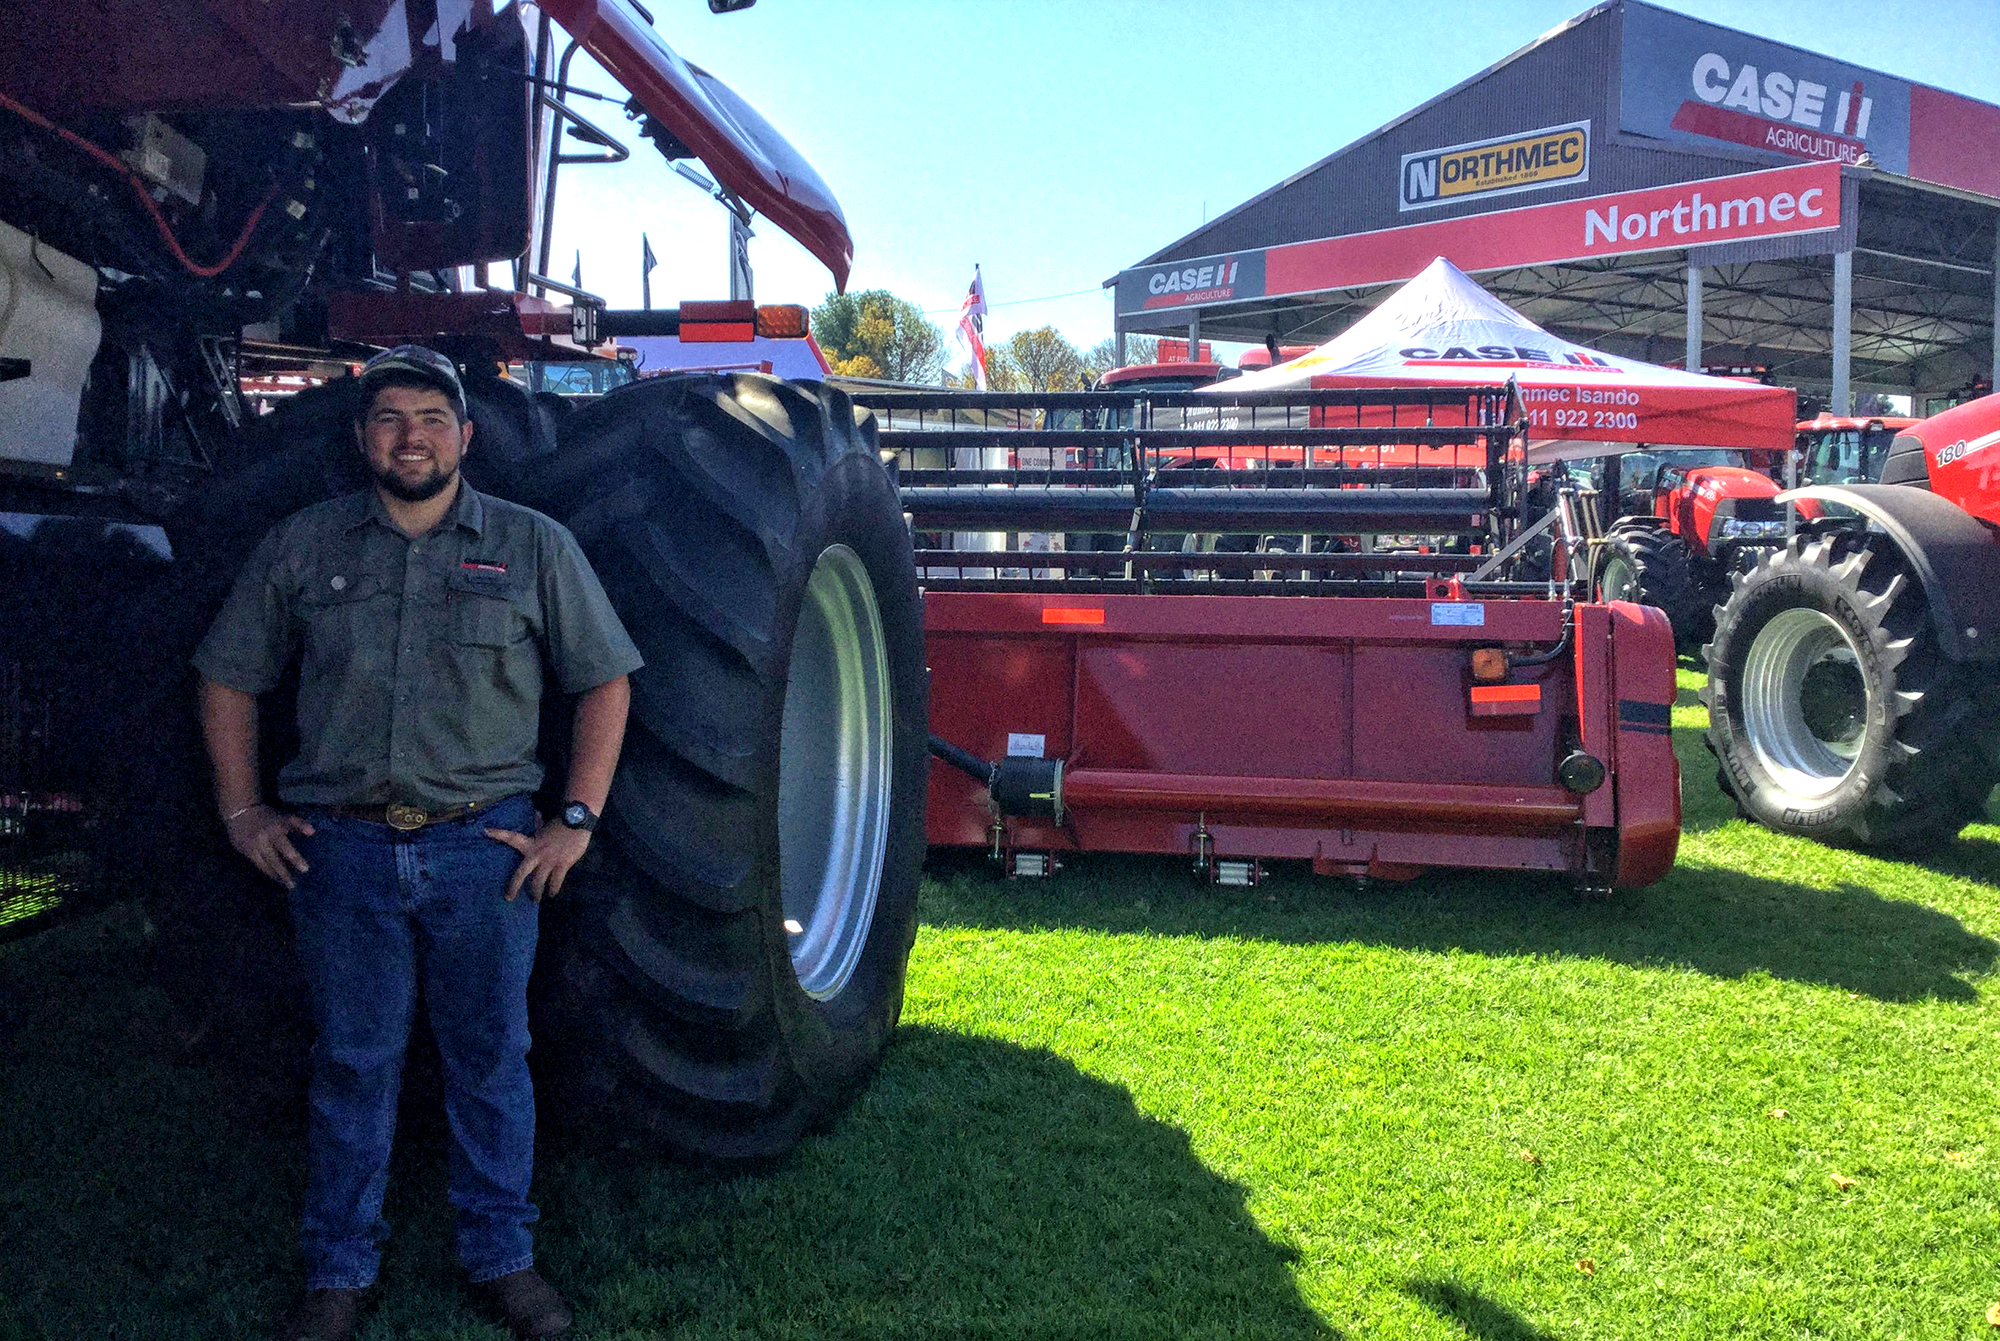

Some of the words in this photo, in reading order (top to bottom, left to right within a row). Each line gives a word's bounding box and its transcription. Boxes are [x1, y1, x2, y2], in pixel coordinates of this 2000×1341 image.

[1692, 52, 1827, 127] CASE
[1765, 126, 1858, 164] AGRICULTURE
[1409, 136, 1579, 200] NORTHMEC
[1584, 188, 1823, 246] Northmec
[1148, 265, 1215, 295] CASE
[1185, 288, 1231, 302] AGRICULTURE
[1398, 345, 1554, 363] CASE
[1576, 386, 1640, 406] Isando
[1555, 408, 1589, 427] 922
[1593, 410, 1638, 430] 2300
[1936, 439, 1967, 468] 180
